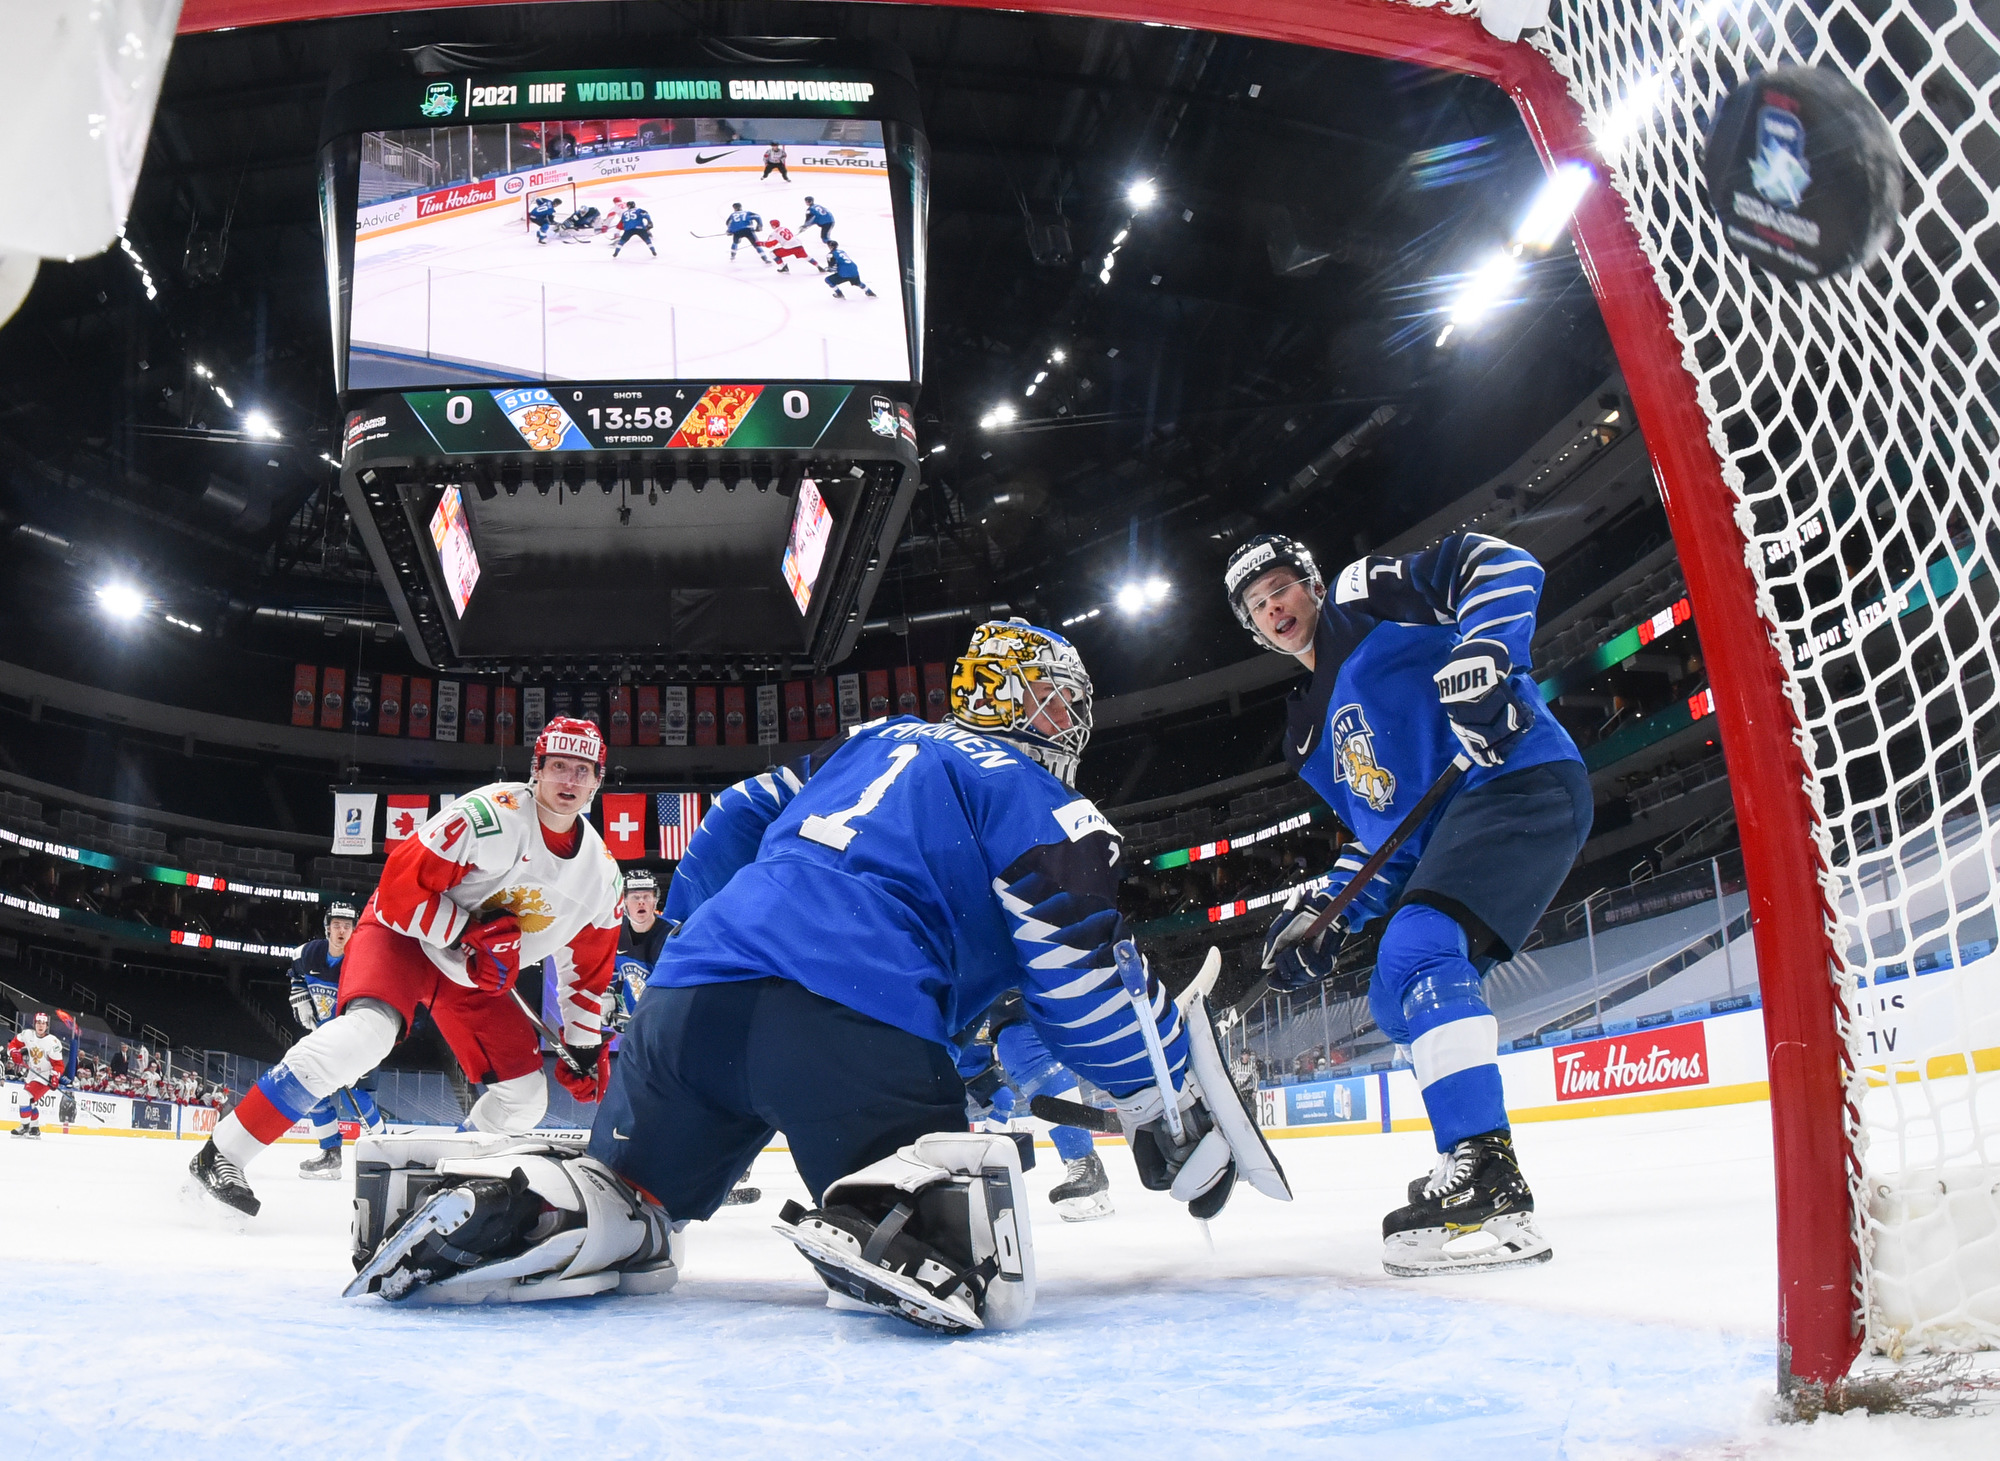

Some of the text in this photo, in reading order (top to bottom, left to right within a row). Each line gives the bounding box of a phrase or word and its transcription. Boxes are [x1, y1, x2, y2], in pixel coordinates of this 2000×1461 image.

[472, 80, 874, 106] 2021 IIHF WORLD JUNIOR CHAMPIONSHIP
[600, 166, 622, 176] Optik
[610, 156, 640, 164] TELUS
[508, 181, 520, 190] Esso
[420, 188, 494, 216] Tim Hortons
[362, 210, 400, 228] Advice
[573, 391, 582, 401] 0
[675, 390, 685, 400] 4
[783, 390, 810, 419] 0
[446, 396, 472, 424] 0
[588, 406, 673, 430] 13:58
[1230, 550, 1272, 587] FINNAIR
[1350, 562, 1360, 592] FIN
[1638, 619, 1655, 646] 50
[1672, 598, 1692, 626] 50
[1797, 625, 1842, 662] JAKPOT
[1438, 666, 1488, 698] RIOR
[1688, 690, 1708, 720] 50
[552, 735, 596, 757] TOY.RU
[799, 744, 919, 851] 1
[1074, 814, 1110, 830] FIN
[19, 836, 44, 852] JACKPOT
[1188, 846, 1200, 862] 50
[1216, 838, 1230, 856] 50
[1231, 834, 1256, 849] CURRENT
[1256, 825, 1278, 842] JACKPOT
[186, 872, 200, 887] 50
[212, 878, 226, 892] 50
[228, 882, 254, 894] CURRENT
[254, 886, 281, 898] JACKPOT
[1208, 905, 1221, 922] 50
[1234, 900, 1246, 916] 50
[1247, 894, 1270, 910] CURRENT
[170, 930, 184, 944] 50
[199, 934, 213, 949] 50
[214, 938, 242, 951] CURRENT
[242, 944, 268, 955] JACKPOT
[625, 966, 646, 980] SUOMI
[1558, 1044, 1700, 1094] Tim Hortons
[92, 1100, 116, 1114] TISSOT
